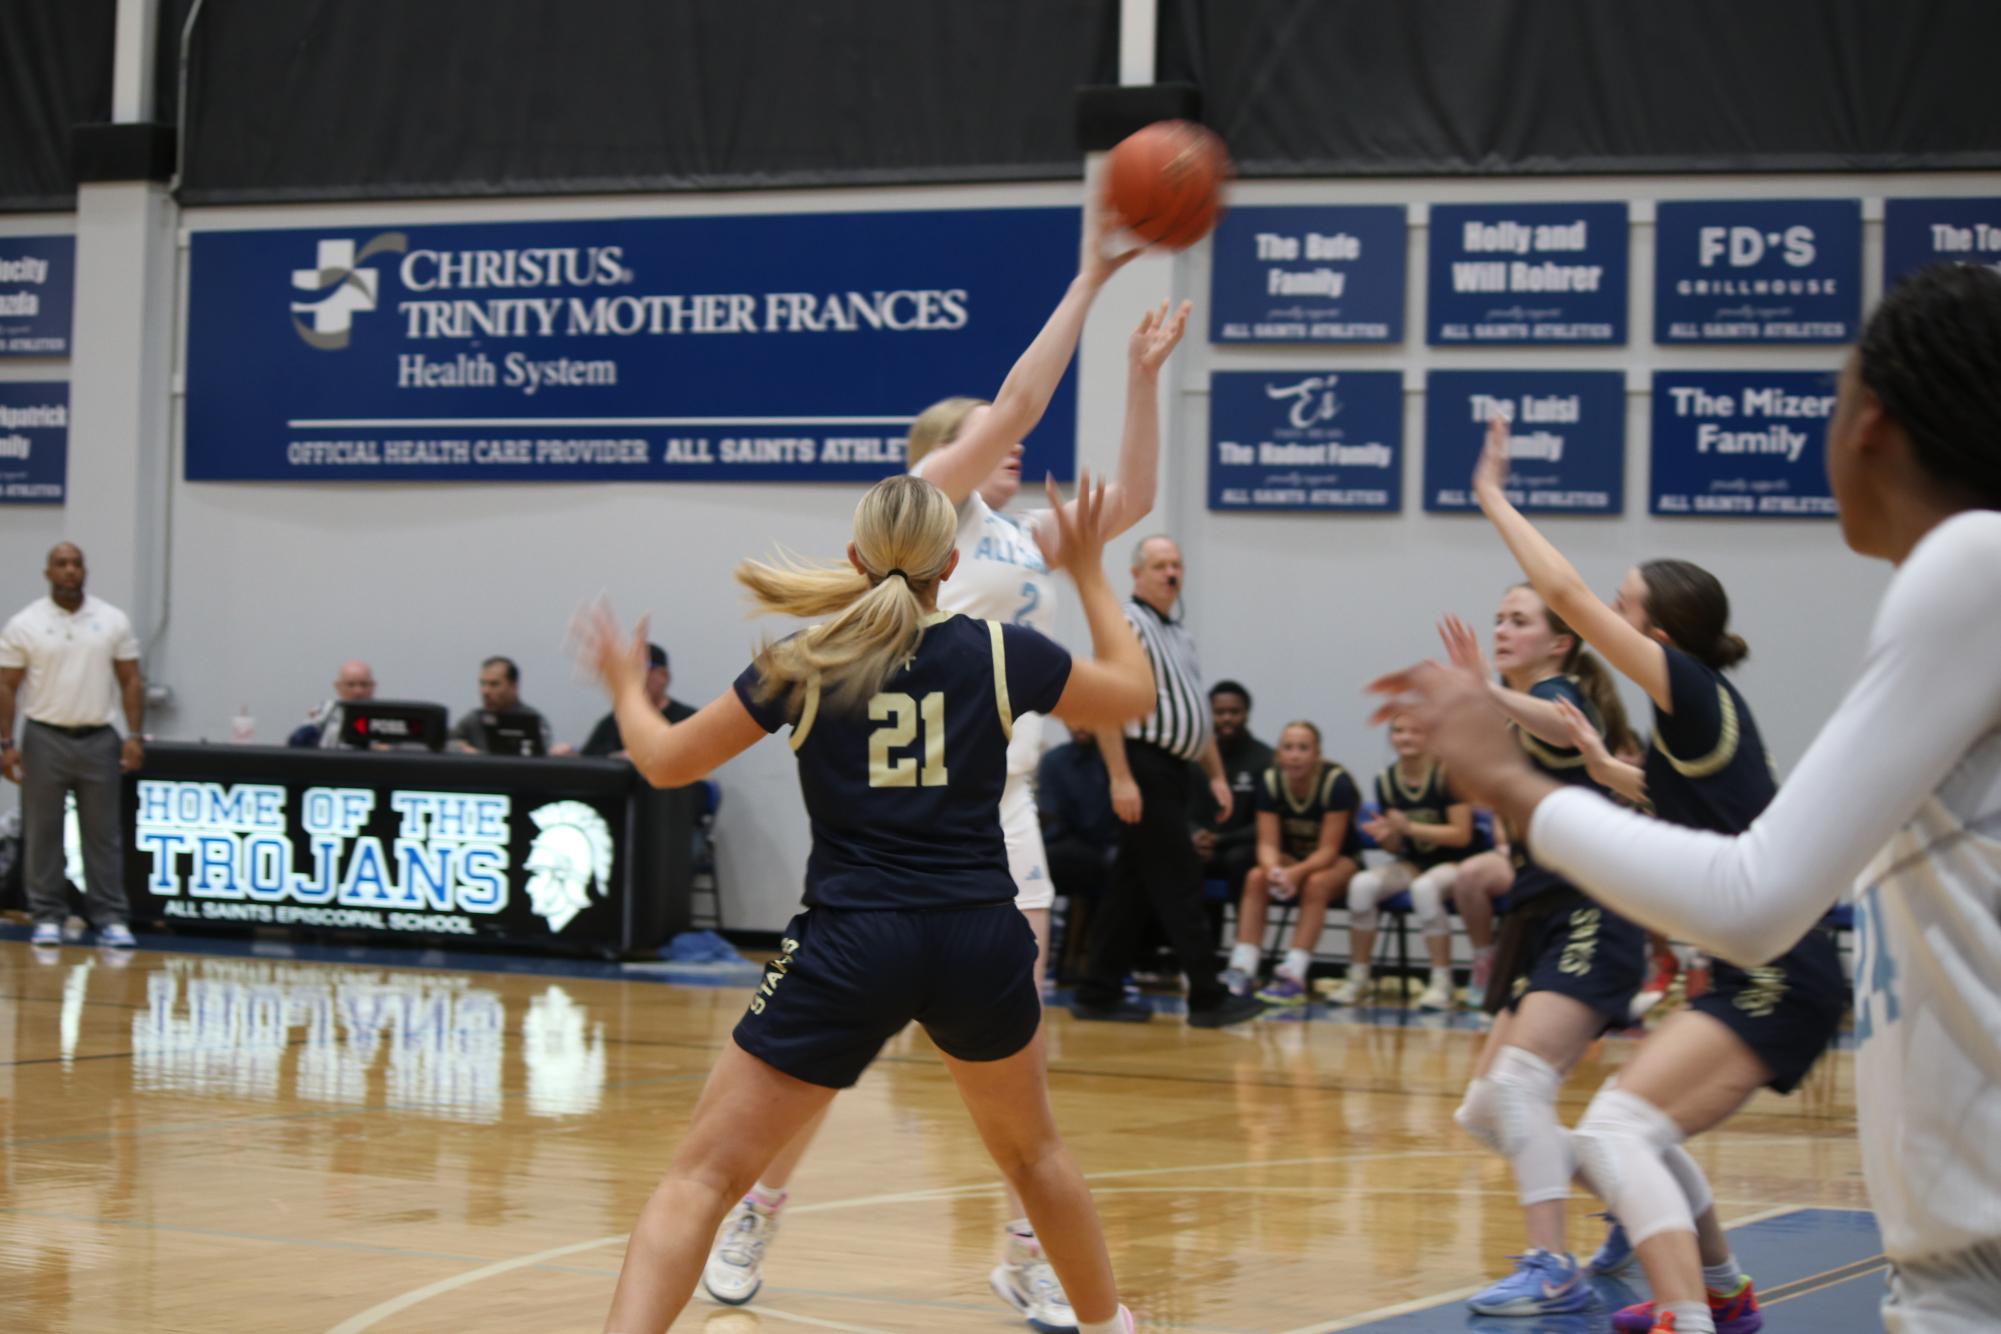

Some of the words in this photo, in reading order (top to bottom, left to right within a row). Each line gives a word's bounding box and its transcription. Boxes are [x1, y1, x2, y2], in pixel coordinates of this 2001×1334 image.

[1256, 233, 1299, 260] The
[1533, 220, 1586, 251] and
[1931, 224, 1973, 251] The
[1268, 268, 1345, 298] Family
[1452, 262, 1506, 292] Will
[1677, 279, 1835, 295] GRILLHOUSE
[399, 298, 562, 338] TRINITY
[567, 294, 766, 335] MOTHER
[765, 289, 967, 332] FRANCES
[398, 353, 496, 387] Health
[504, 352, 616, 395] System
[1469, 395, 1515, 423] The
[1669, 387, 1734, 417] The
[1743, 387, 1836, 417] Mizer
[287, 441, 381, 465] OFFICIAL
[381, 440, 470, 464] HEALTH
[473, 440, 532, 464] CARE
[535, 439, 649, 463] PROVIDER
[664, 439, 714, 463] ALL
[720, 438, 816, 463] SAINTS
[1697, 424, 1806, 461] Family
[868, 691, 948, 787] 21
[137, 780, 286, 832] HOME
[302, 787, 377, 838] OF
[391, 790, 510, 844] THE
[136, 828, 509, 915] TROJANS
[164, 900, 199, 918] ALL
[202, 902, 274, 922] SAINTS
[275, 906, 388, 929] EPISCOPAL
[389, 912, 476, 935] SCHOOL
